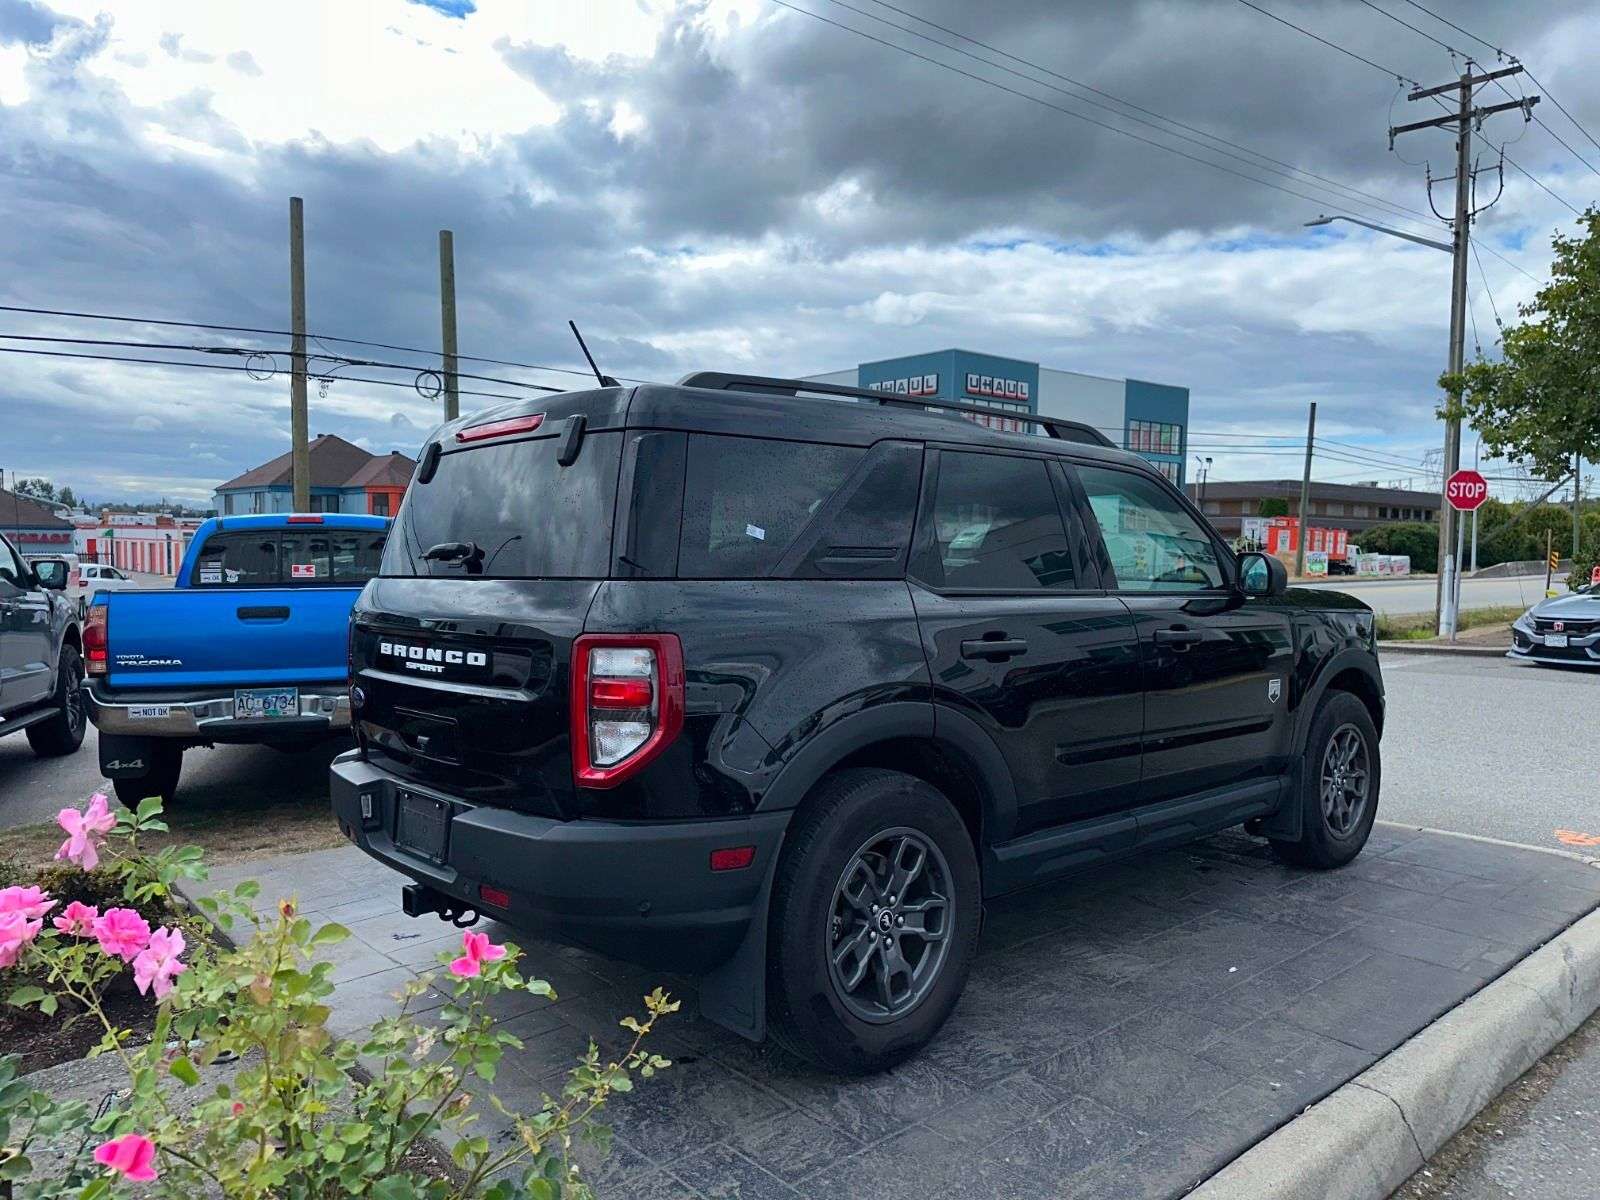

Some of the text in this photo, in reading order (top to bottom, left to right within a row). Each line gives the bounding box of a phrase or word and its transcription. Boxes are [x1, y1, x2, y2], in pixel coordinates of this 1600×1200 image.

[1448, 481, 1485, 498] STOP
[380, 642, 487, 666] BRONCO
[116, 659, 183, 667] TACOMA
[405, 661, 446, 673] SPORT
[262, 694, 296, 710] 6734
[142, 707, 168, 716] NOT OK
[106, 759, 144, 770] 4x4
